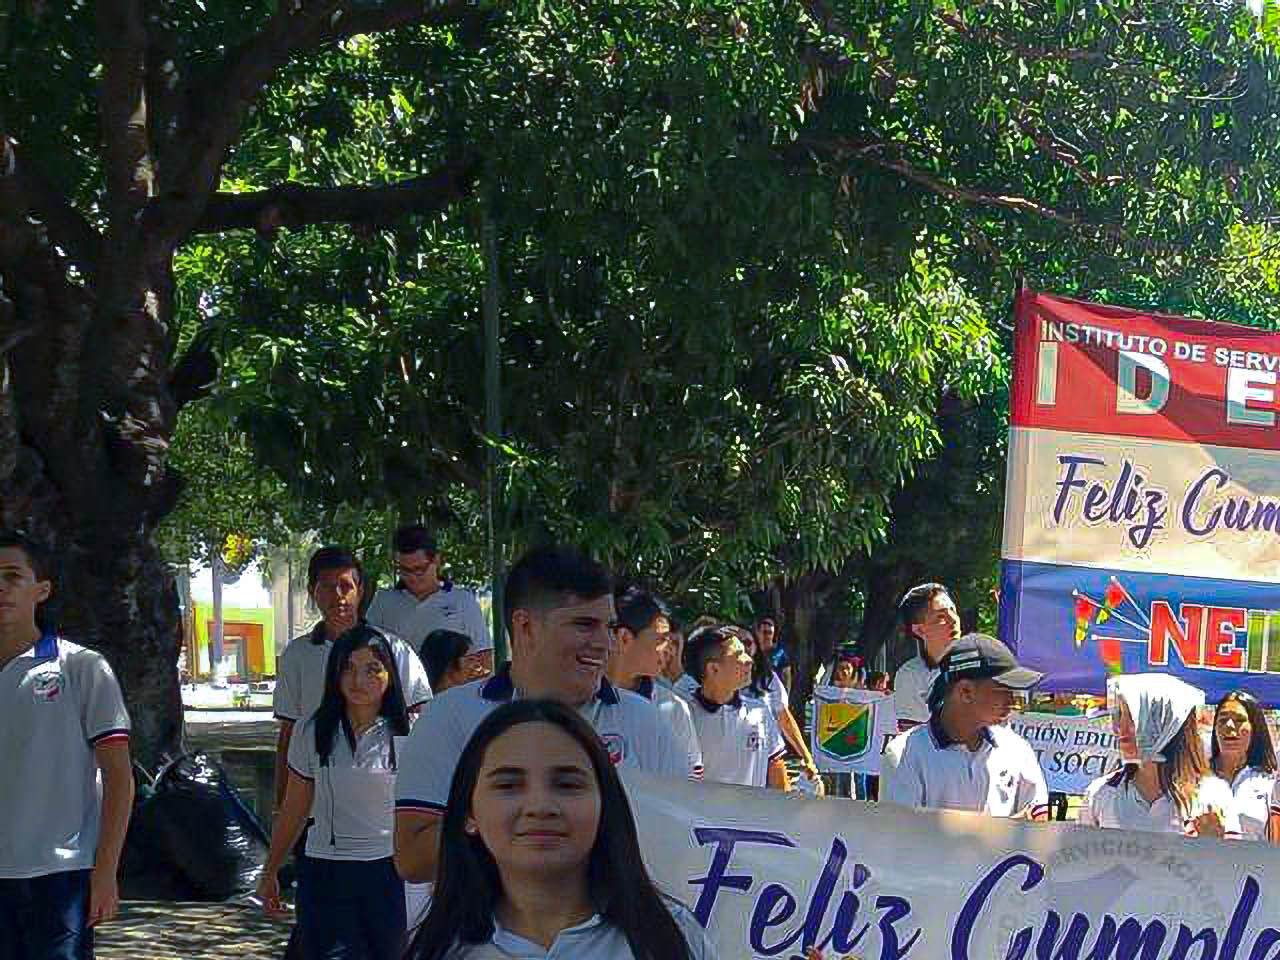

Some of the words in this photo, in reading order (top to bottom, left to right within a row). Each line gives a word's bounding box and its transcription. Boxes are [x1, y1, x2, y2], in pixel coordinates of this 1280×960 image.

[1040, 320, 1168, 357] INSTITUTO
[1174, 341, 1207, 362] DE
[1055, 456, 1168, 549] Feliz
[1074, 730, 1120, 749] EDU
